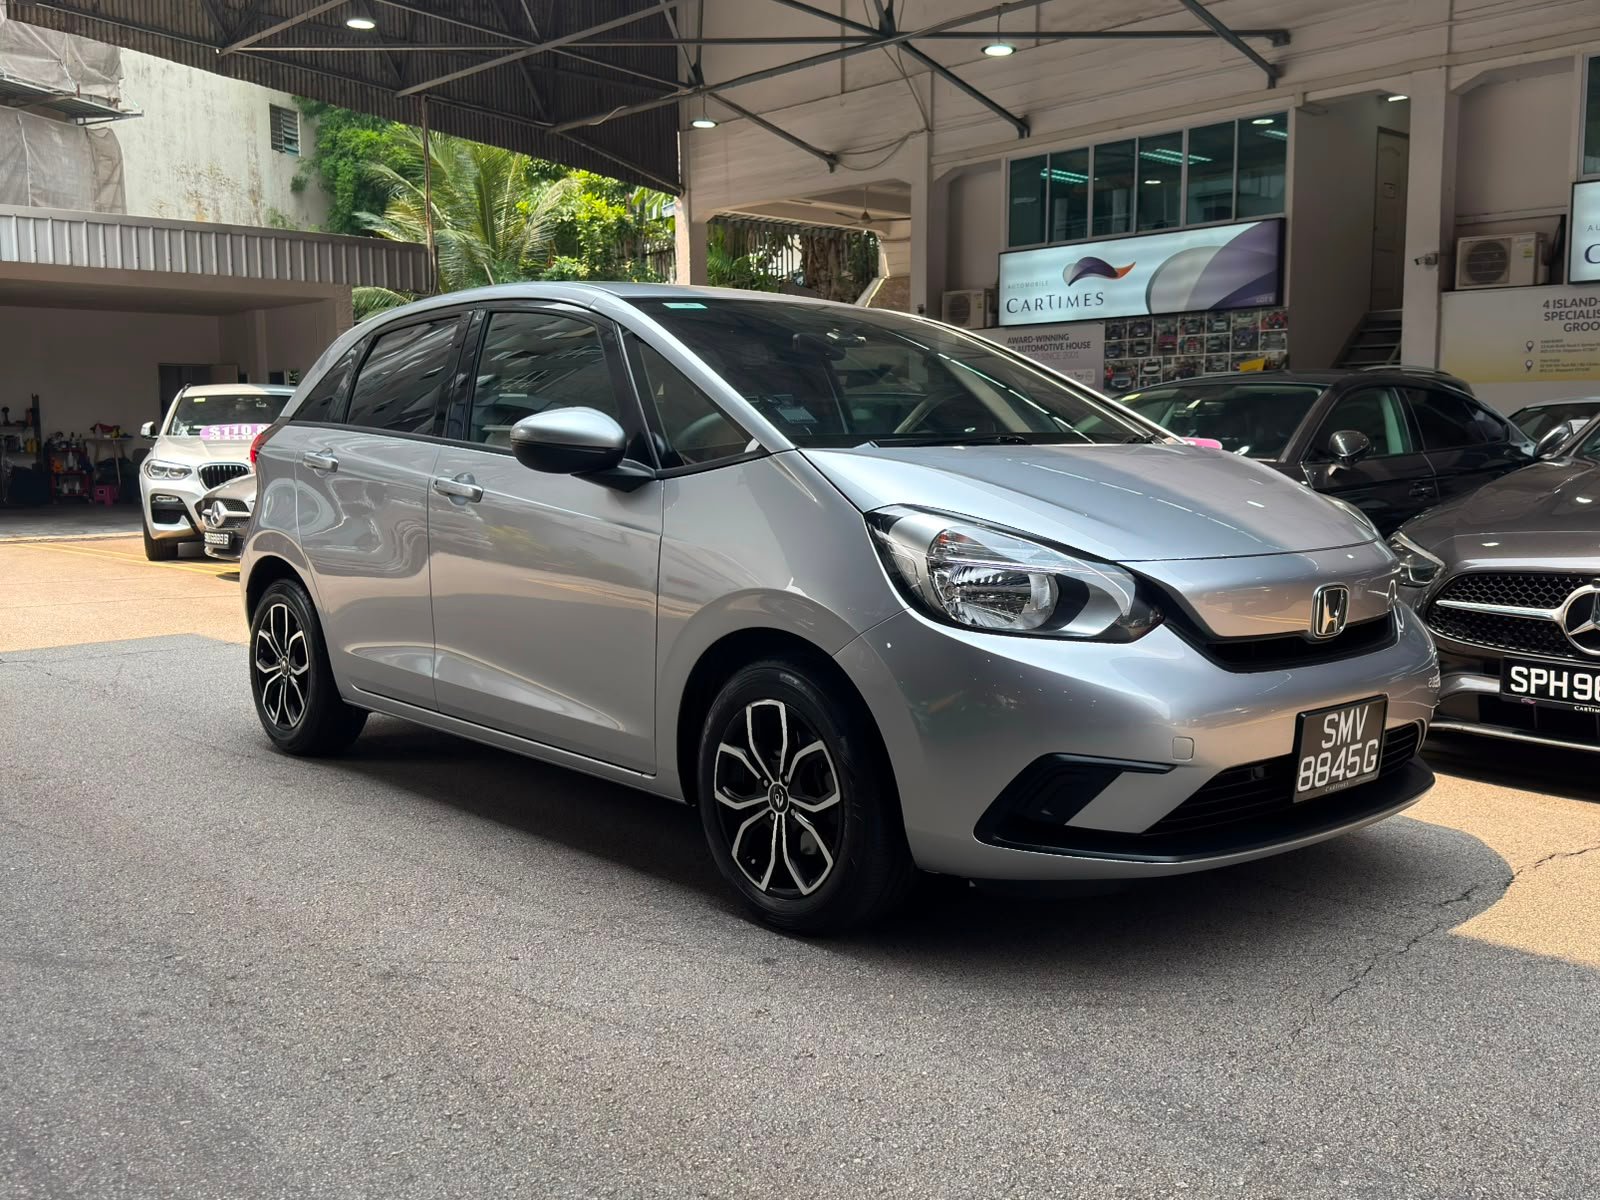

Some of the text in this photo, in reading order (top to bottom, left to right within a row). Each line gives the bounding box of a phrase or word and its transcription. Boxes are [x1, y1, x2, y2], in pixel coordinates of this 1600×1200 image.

[1007, 280, 1049, 289] AUTOMOBILE
[1543, 300, 1550, 309] 4
[1007, 333, 1070, 344] AWARD-WINNING
[1018, 343, 1065, 353] AUTOMOTIVE
[1066, 341, 1091, 350] HOUSE
[1321, 705, 1369, 749] SMV
[1297, 739, 1379, 792] 8845G
